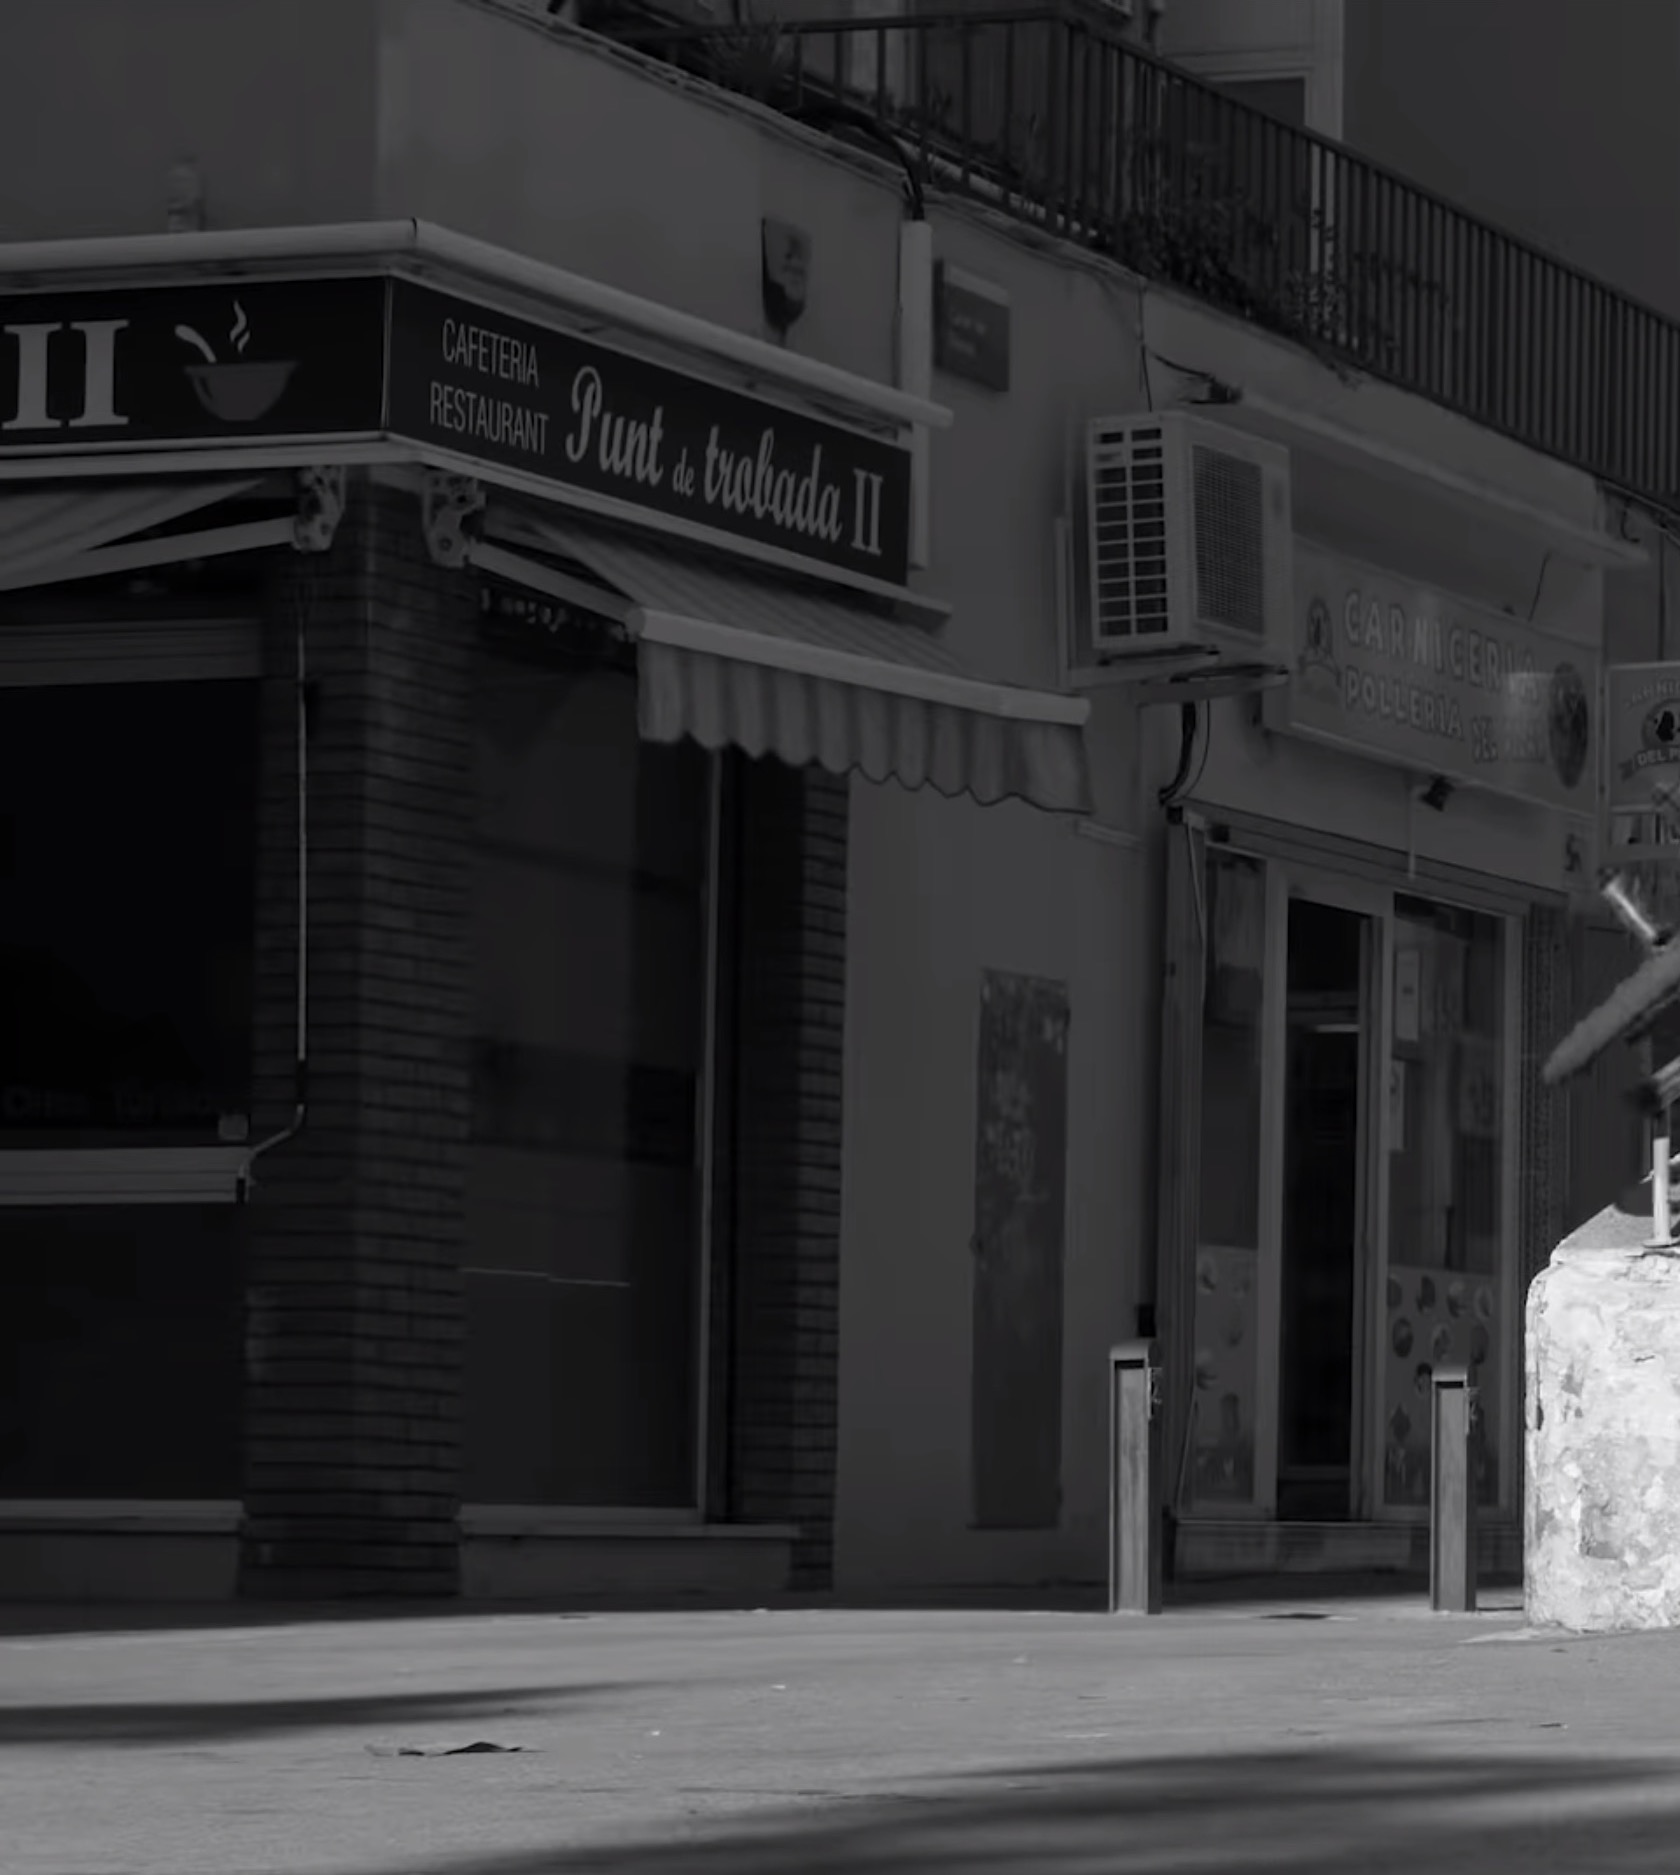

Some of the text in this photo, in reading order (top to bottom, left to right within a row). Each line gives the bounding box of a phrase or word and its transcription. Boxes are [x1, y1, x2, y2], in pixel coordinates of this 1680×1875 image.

[1, 319, 130, 430] II
[442, 318, 540, 388] CAFETERIA
[430, 381, 549, 456] RESTAURANT
[566, 365, 883, 557] Punt de trobada II
[1345, 664, 1466, 742] POLLERIA
